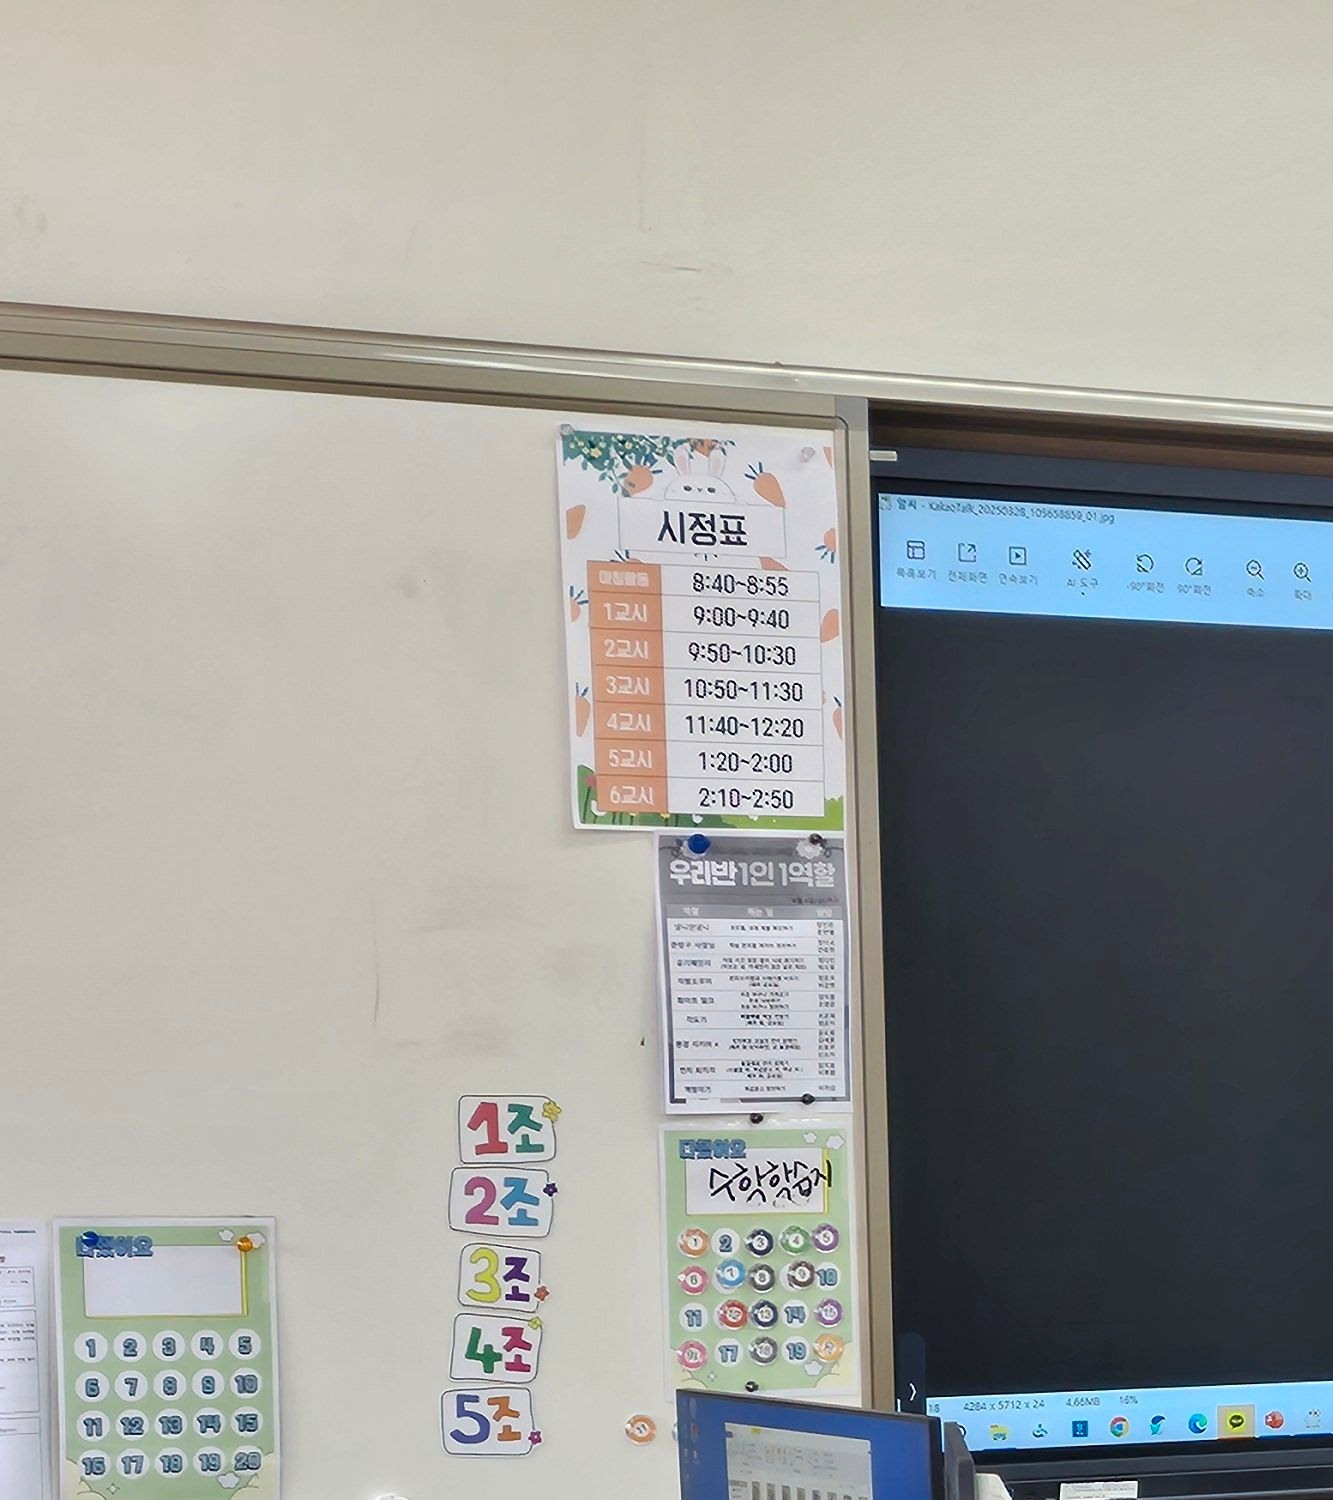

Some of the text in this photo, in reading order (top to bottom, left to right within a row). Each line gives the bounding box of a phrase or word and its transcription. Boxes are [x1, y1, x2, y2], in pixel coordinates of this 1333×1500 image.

[657, 510, 748, 546] 시정표
[692, 573, 789, 597] 8:40~8:55
[604, 602, 789, 628] 1교시 9:00~9:40
[604, 638, 796, 666] 2교시 9:50~10:30
[606, 676, 803, 702] 3교시 10:50~11:30
[606, 711, 804, 738] 4교시 11:40~12:20
[609, 747, 793, 773] 5교시 1:20~2:00
[609, 784, 794, 809] 6교시 2:10~2:50
[670, 859, 738, 887] 우리반
[779, 861, 836, 888] 1역할
[467, 1101, 545, 1156] 1조
[464, 1176, 540, 1226] 2조
[719, 1234, 733, 1253] 2
[466, 1247, 531, 1303] 3조
[816, 1268, 838, 1287] 10
[684, 1309, 702, 1328] 11
[85, 1335, 252, 1358] 1 2 3 4 5
[464, 1326, 532, 1373] 4조
[717, 1344, 739, 1363] 17
[85, 1378, 100, 1398] 6
[124, 1377, 138, 1397] 7
[234, 1374, 258, 1394] 10
[997, 1399, 1022, 1411] 5712
[83, 1413, 258, 1437] 11 12 13 14 15
[450, 1394, 522, 1444] 5조
[82, 1456, 105, 1476] 16
[121, 1455, 144, 1475] 17
[198, 1452, 222, 1472] 19
[234, 1451, 262, 1471] 20
